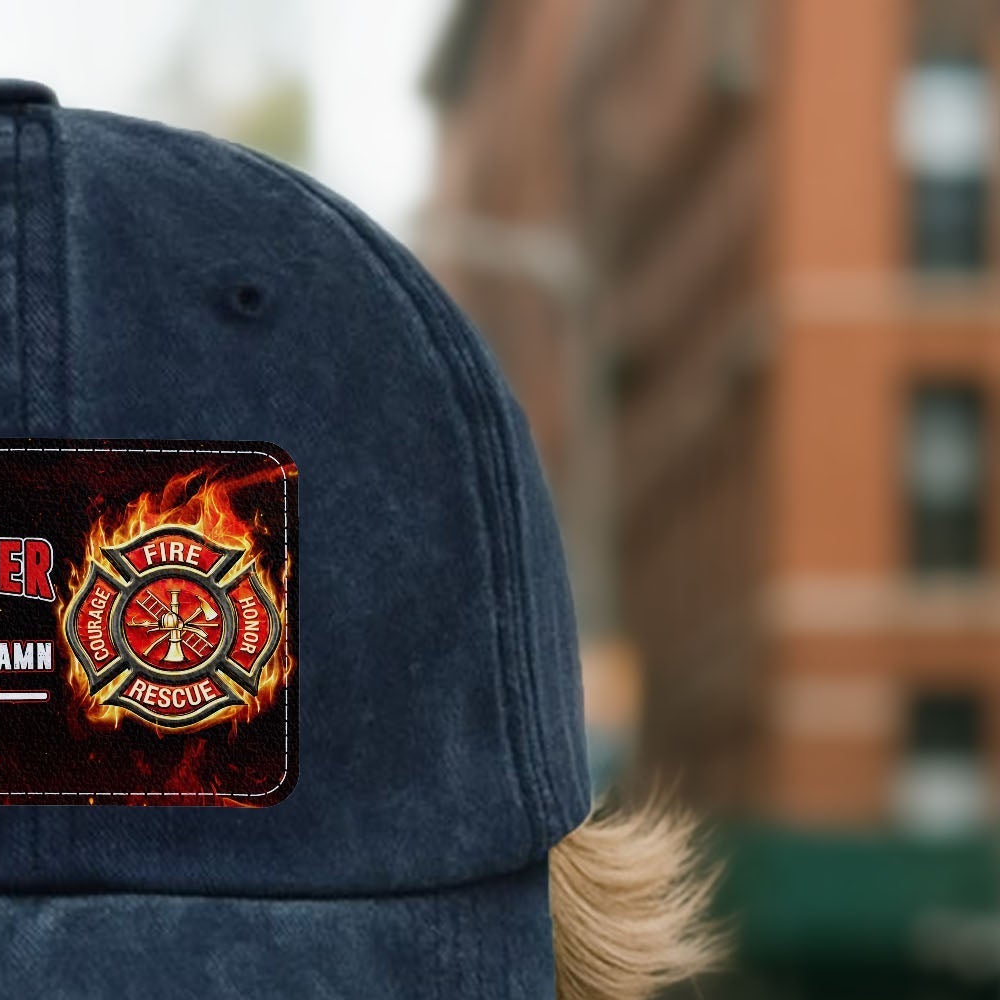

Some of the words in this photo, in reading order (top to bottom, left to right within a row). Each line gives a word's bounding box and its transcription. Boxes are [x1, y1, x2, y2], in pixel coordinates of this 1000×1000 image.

[143, 541, 203, 566] FIRE
[87, 587, 111, 661] COURAGE
[239, 596, 260, 655] HONOR
[128, 678, 217, 708] RESCUE
